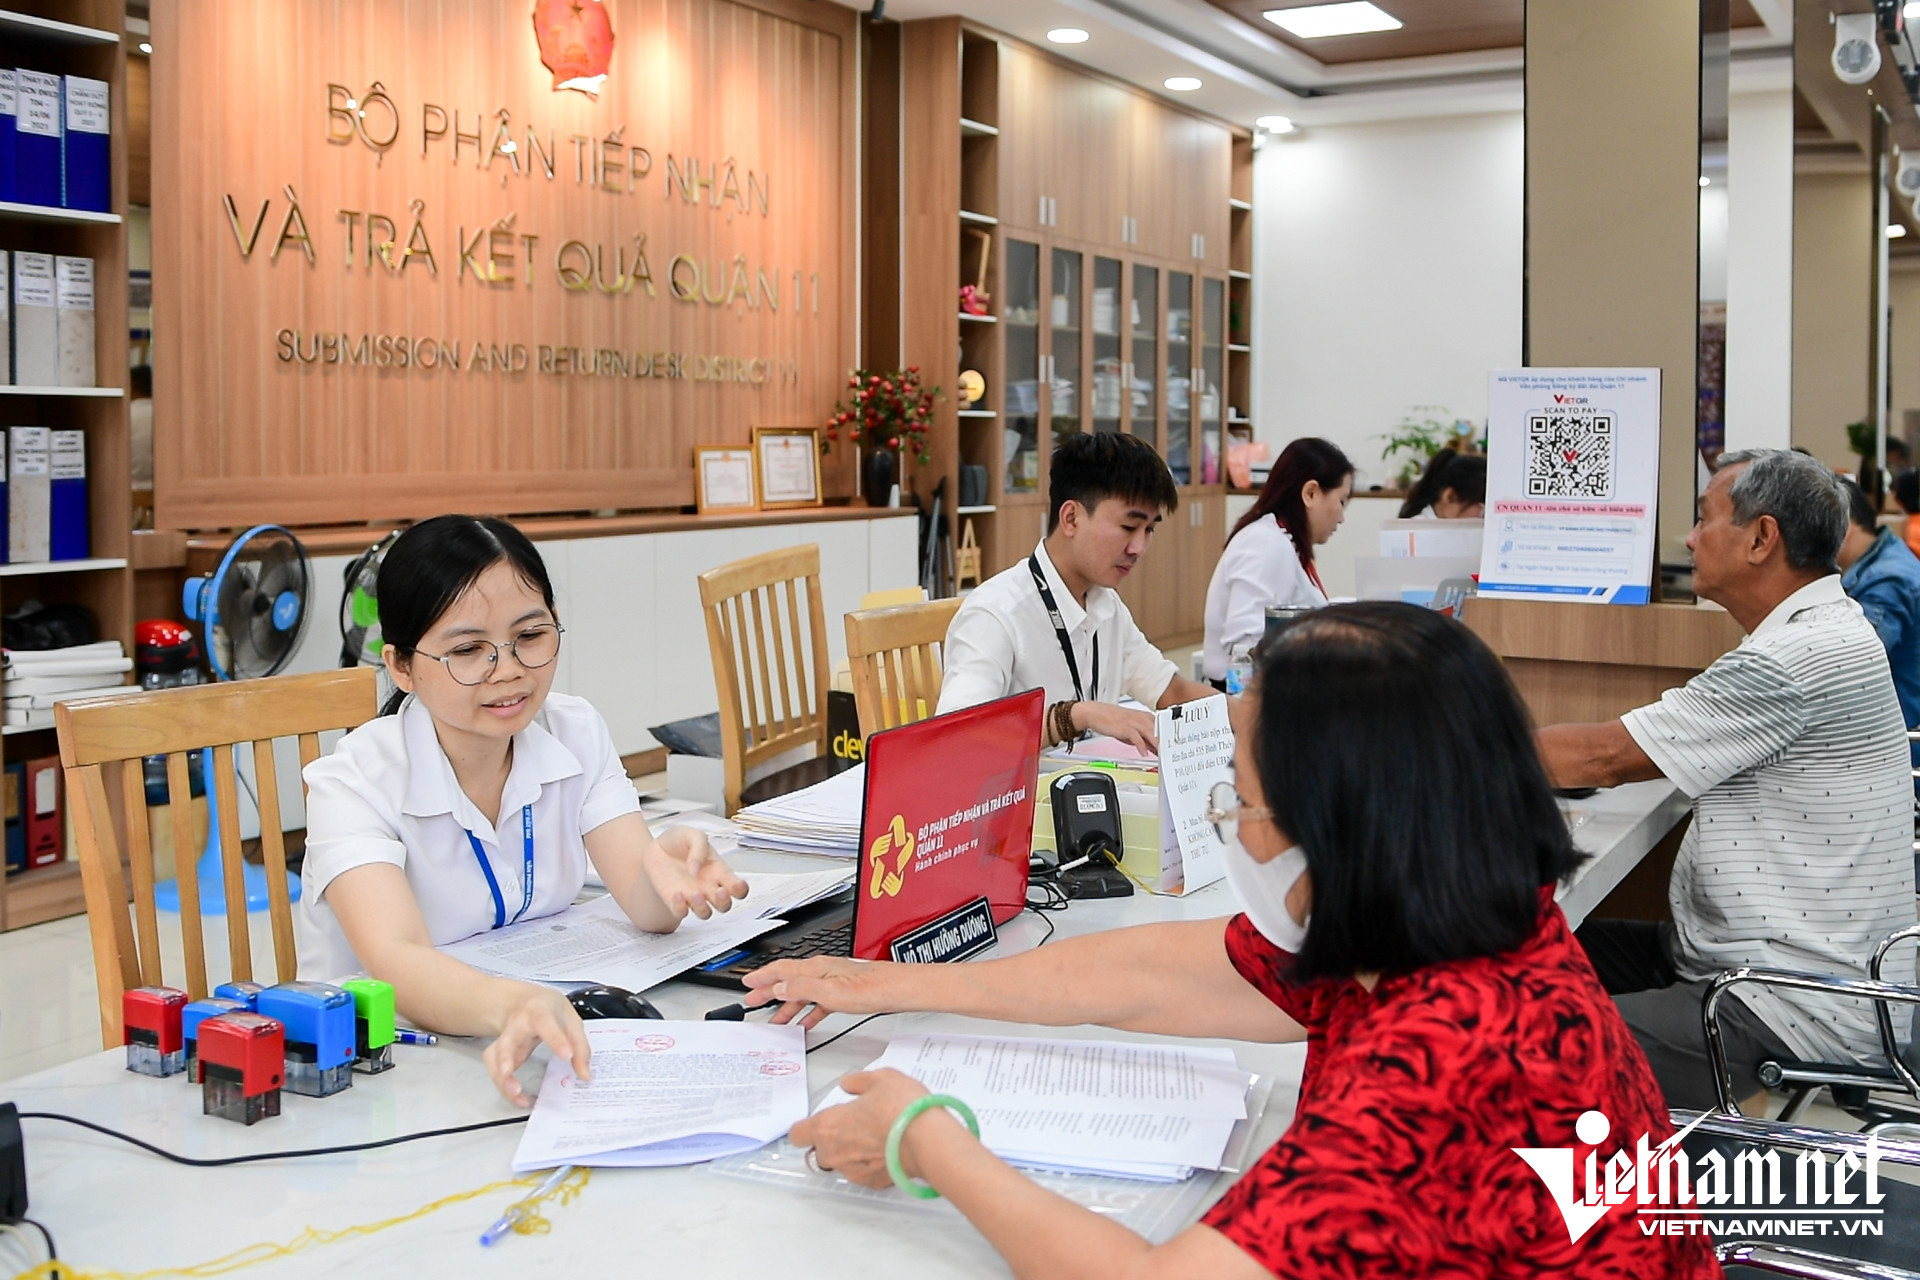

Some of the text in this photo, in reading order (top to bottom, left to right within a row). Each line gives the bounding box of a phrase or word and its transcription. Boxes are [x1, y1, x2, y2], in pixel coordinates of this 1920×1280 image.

[328, 81, 769, 223] BỘ PHẬN TIẾP NHẬN
[223, 184, 820, 318] VÀ TRẢ KẾT QUẢ QUẬN 11
[276, 328, 459, 371] SUBMISSION
[466, 341, 528, 374] AND
[536, 345, 630, 379] RETURN
[632, 350, 688, 380] DESK
[693, 353, 773, 385] DISTRICT
[1582, 407, 1598, 415] PAY
